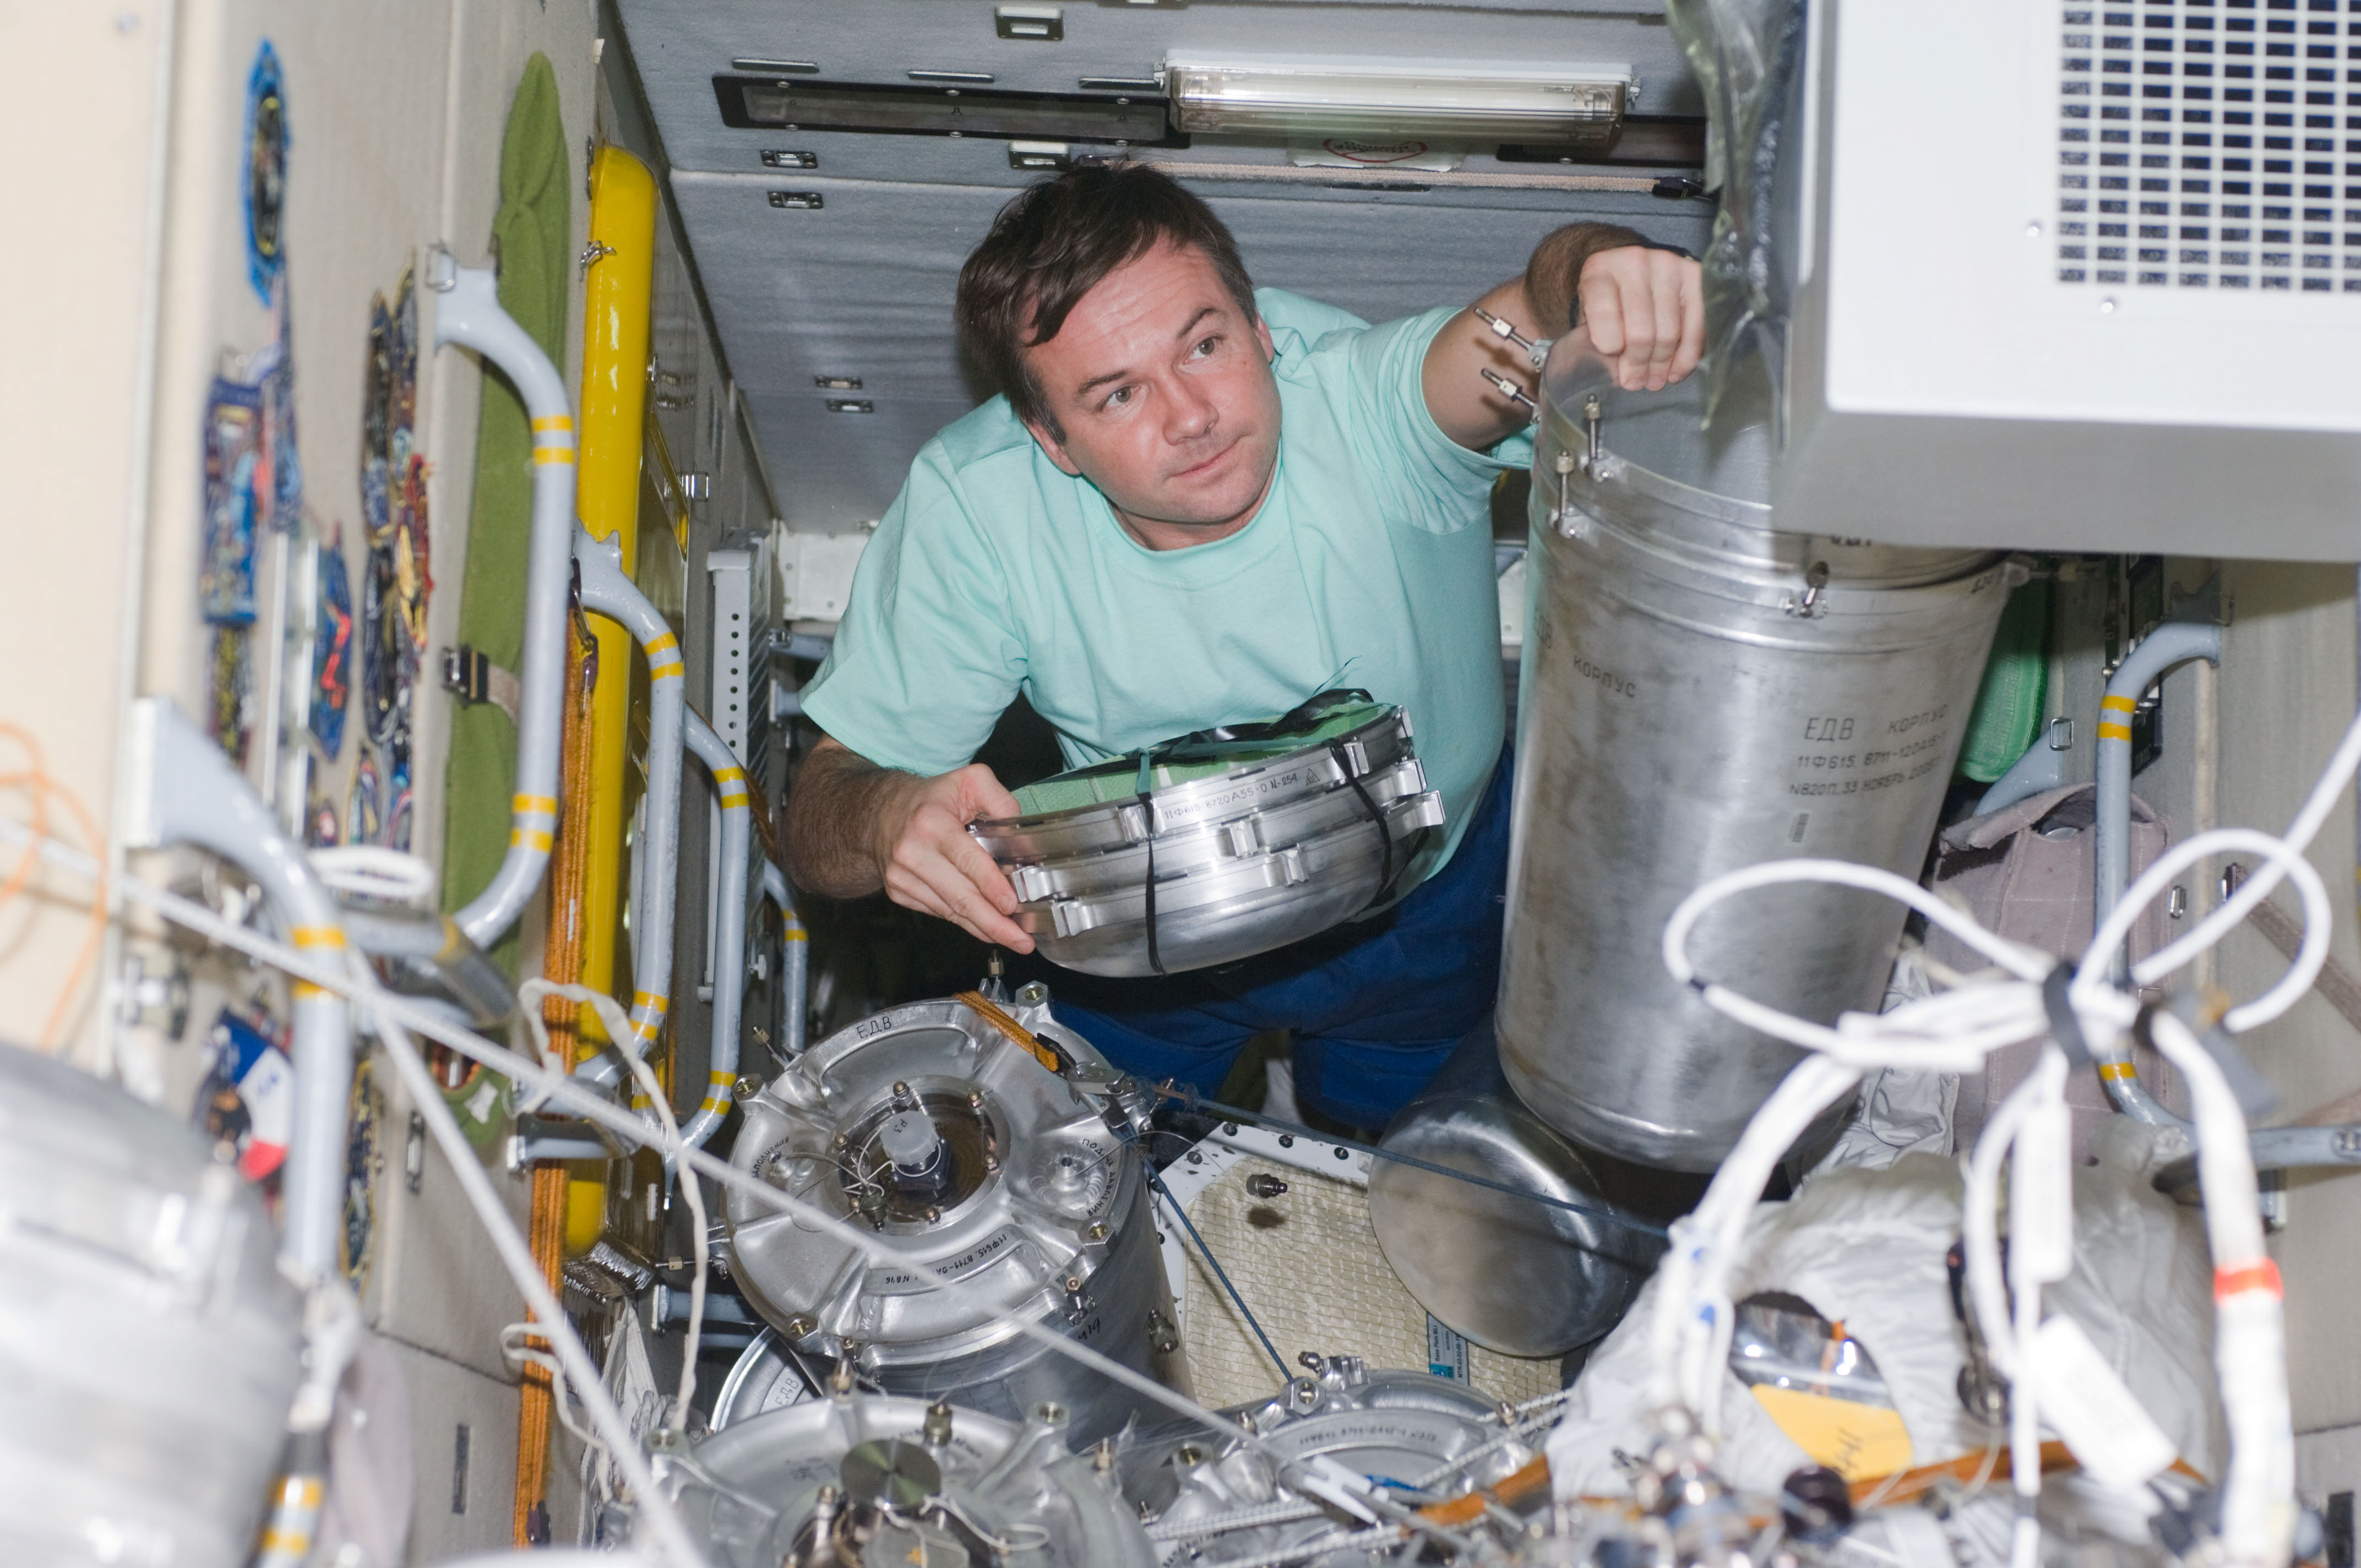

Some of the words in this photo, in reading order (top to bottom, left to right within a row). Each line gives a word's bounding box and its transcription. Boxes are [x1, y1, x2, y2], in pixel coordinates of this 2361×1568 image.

[1573, 655, 1636, 698] КОРПУС
[1805, 717, 1854, 742] ЕДВ
[1887, 704, 1948, 734] КОРПУС
[856, 1016, 891, 1038] ЕДВ
[1082, 1139, 1114, 1167] ПОДЧА
[1086, 1171, 1116, 1217] ДАВЛЕНИЯ
[775, 1378, 799, 1406] ЕДВ
